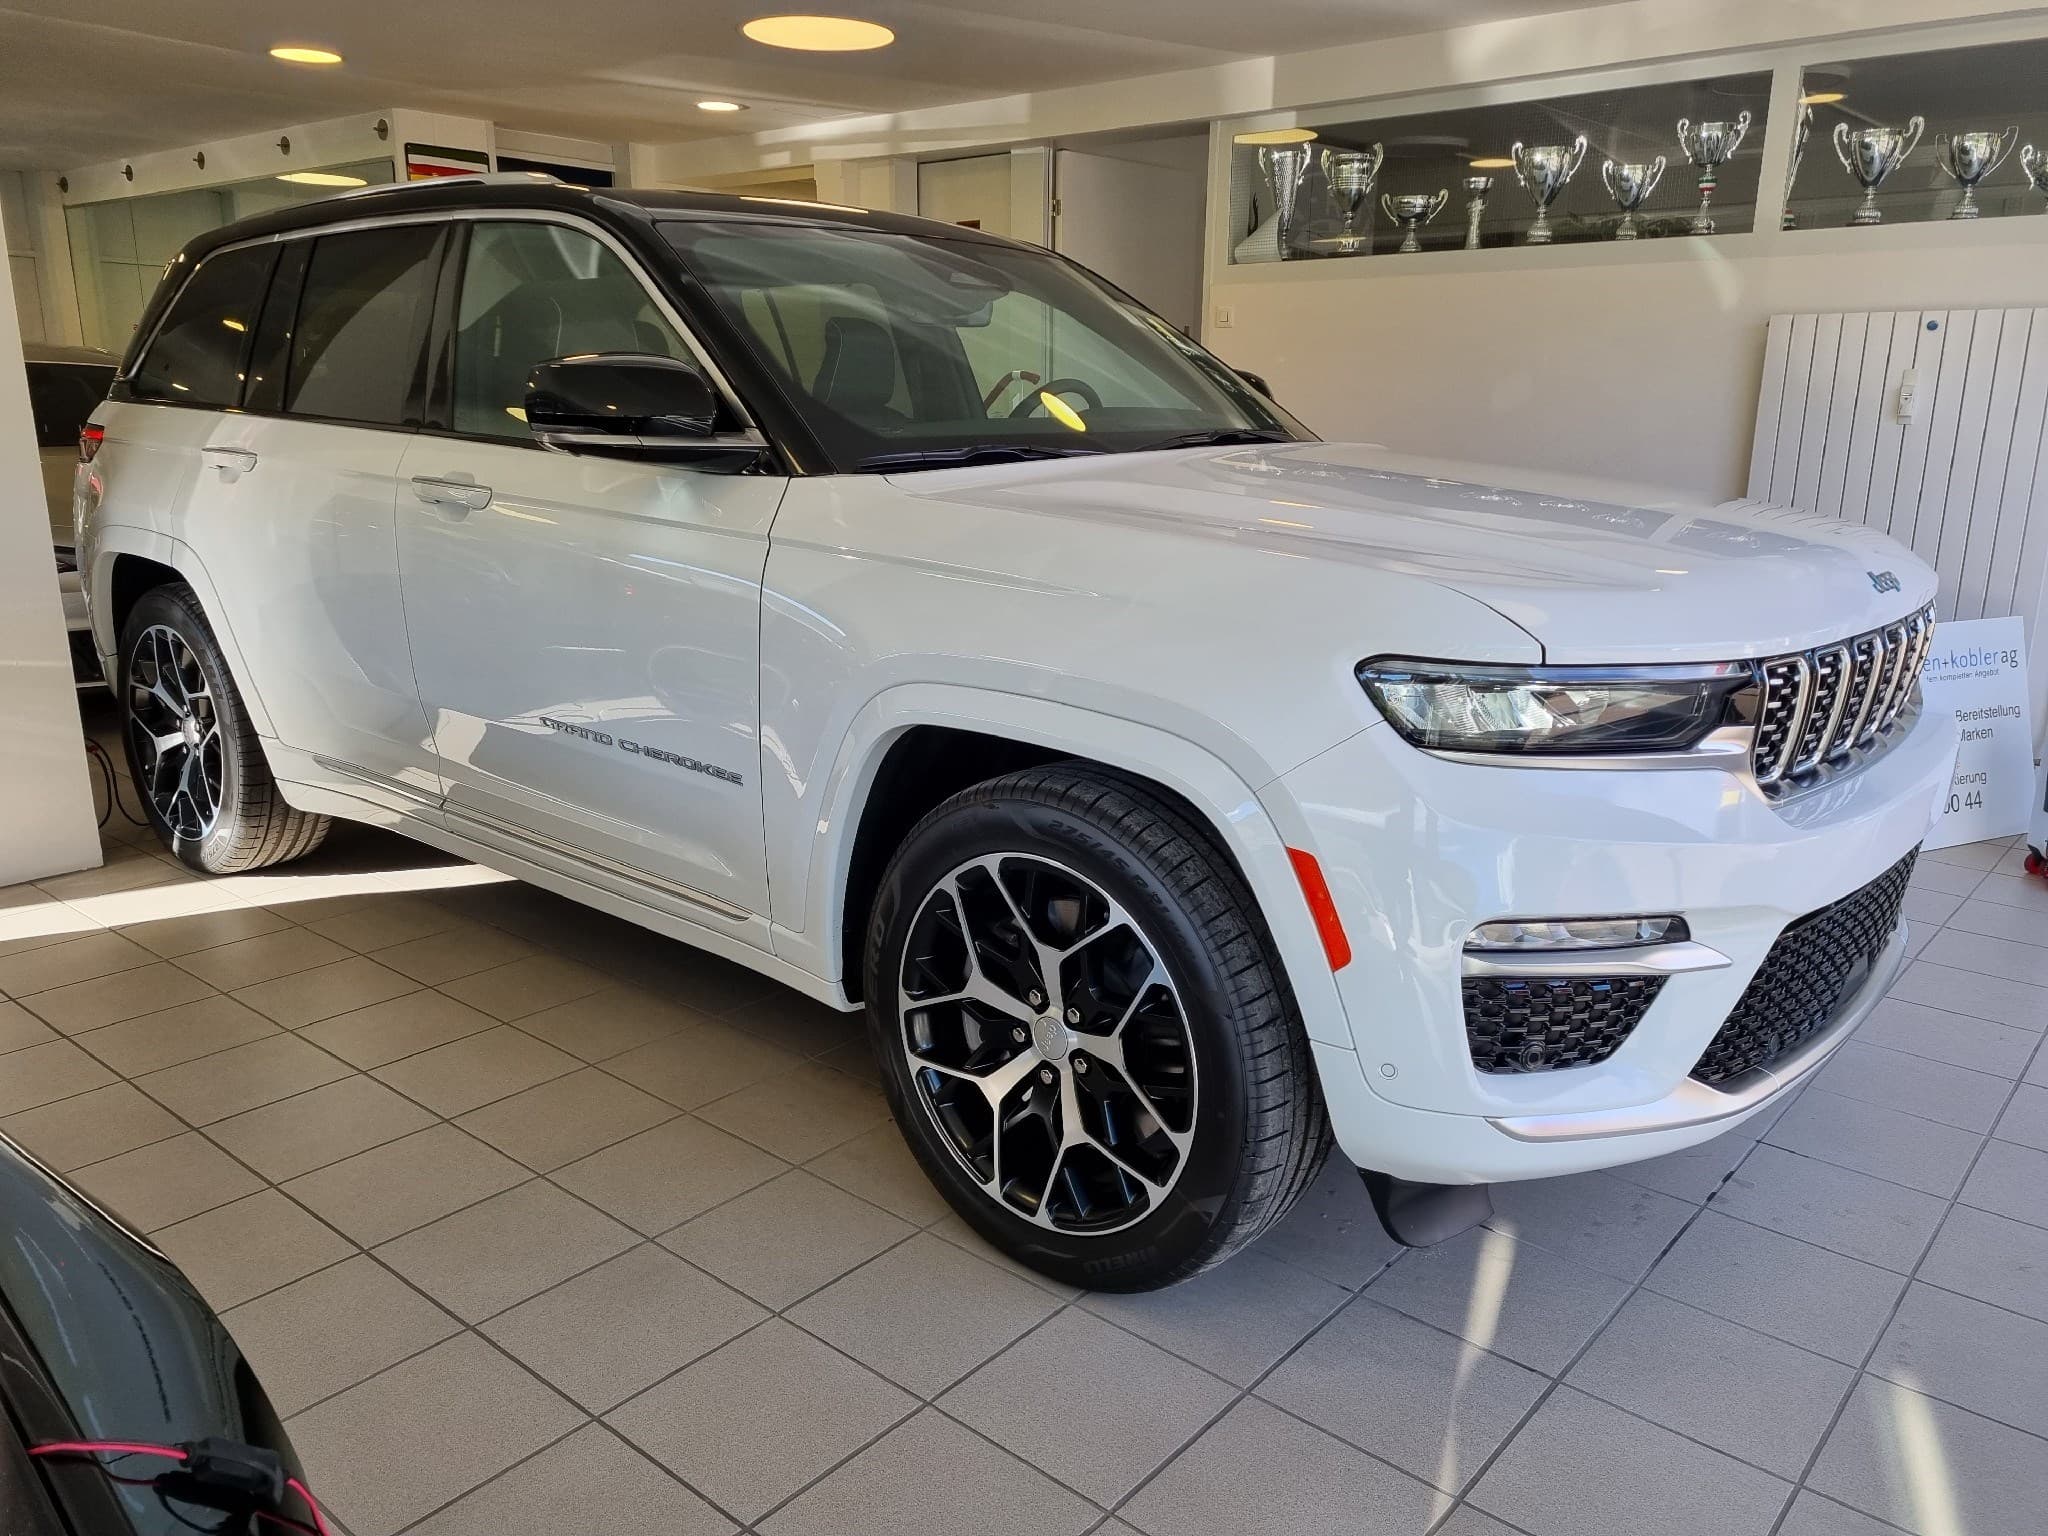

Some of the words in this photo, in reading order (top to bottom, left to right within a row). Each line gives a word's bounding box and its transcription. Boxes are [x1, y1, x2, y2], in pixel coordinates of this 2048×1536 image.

[1974, 668, 2000, 678] Angebot
[1955, 704, 2021, 722] Bereitstellung
[539, 716, 613, 746] GRAND
[618, 738, 744, 787] CHEROKEE
[1964, 789, 1983, 810] 44
